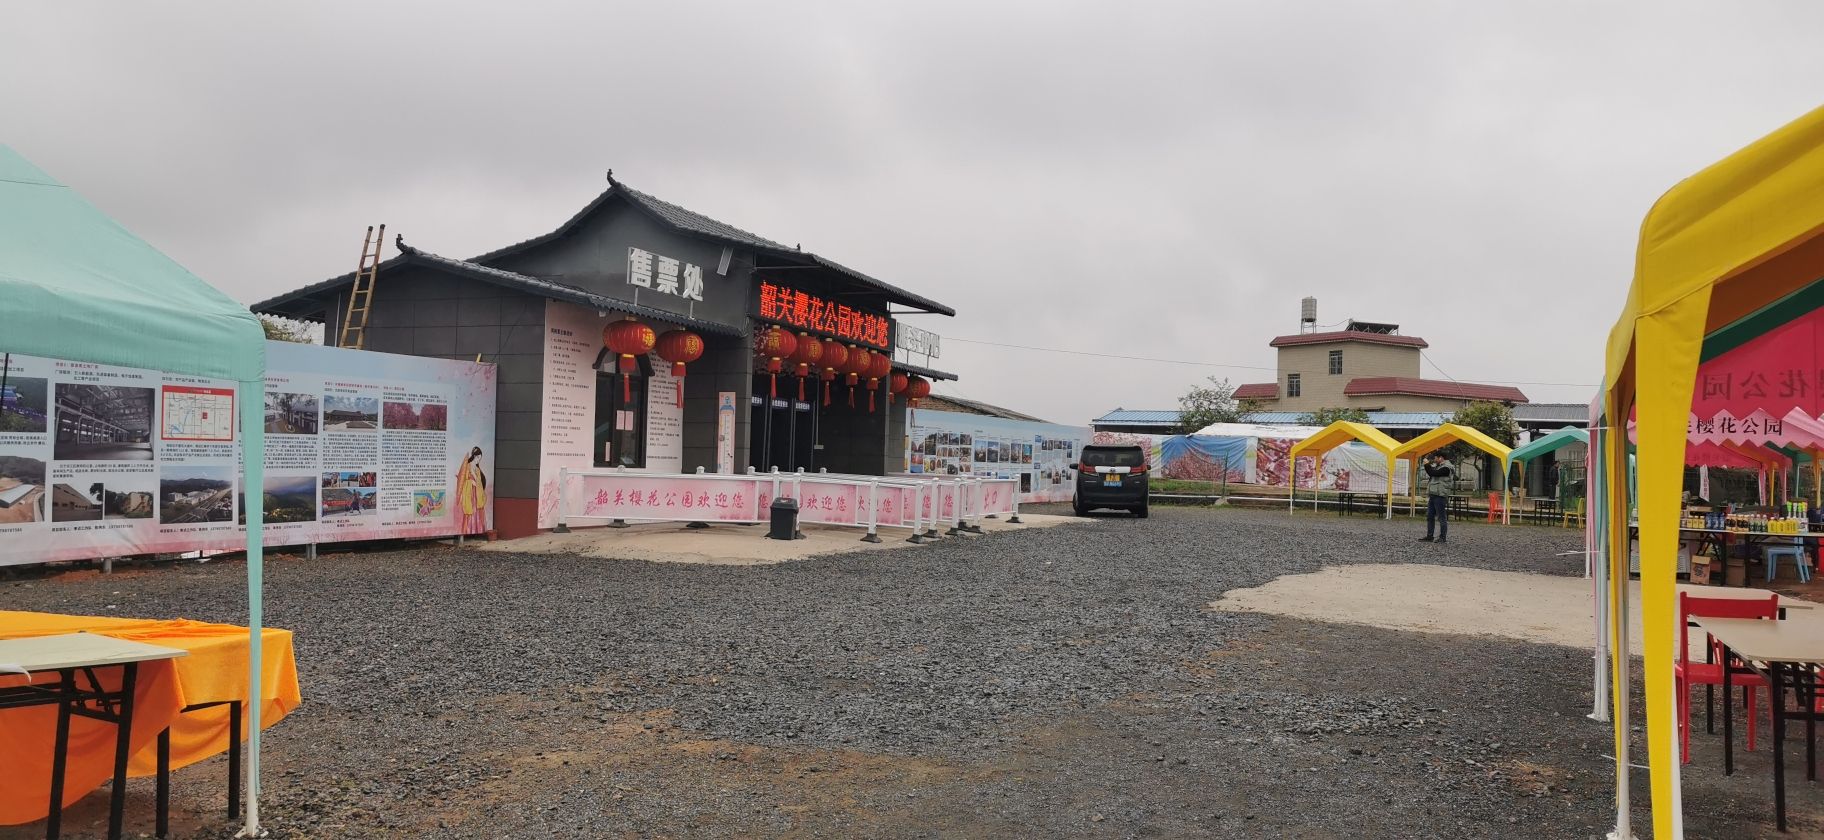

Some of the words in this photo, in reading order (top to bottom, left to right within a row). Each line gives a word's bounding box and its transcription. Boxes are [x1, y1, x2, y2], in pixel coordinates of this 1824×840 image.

[630, 249, 704, 301] 售票处
[760, 282, 889, 347] 韶关樱花公园欢迎您
[594, 488, 745, 509] 韶关樱花公园欢迎您
[800, 493, 847, 512] 欢迎您
